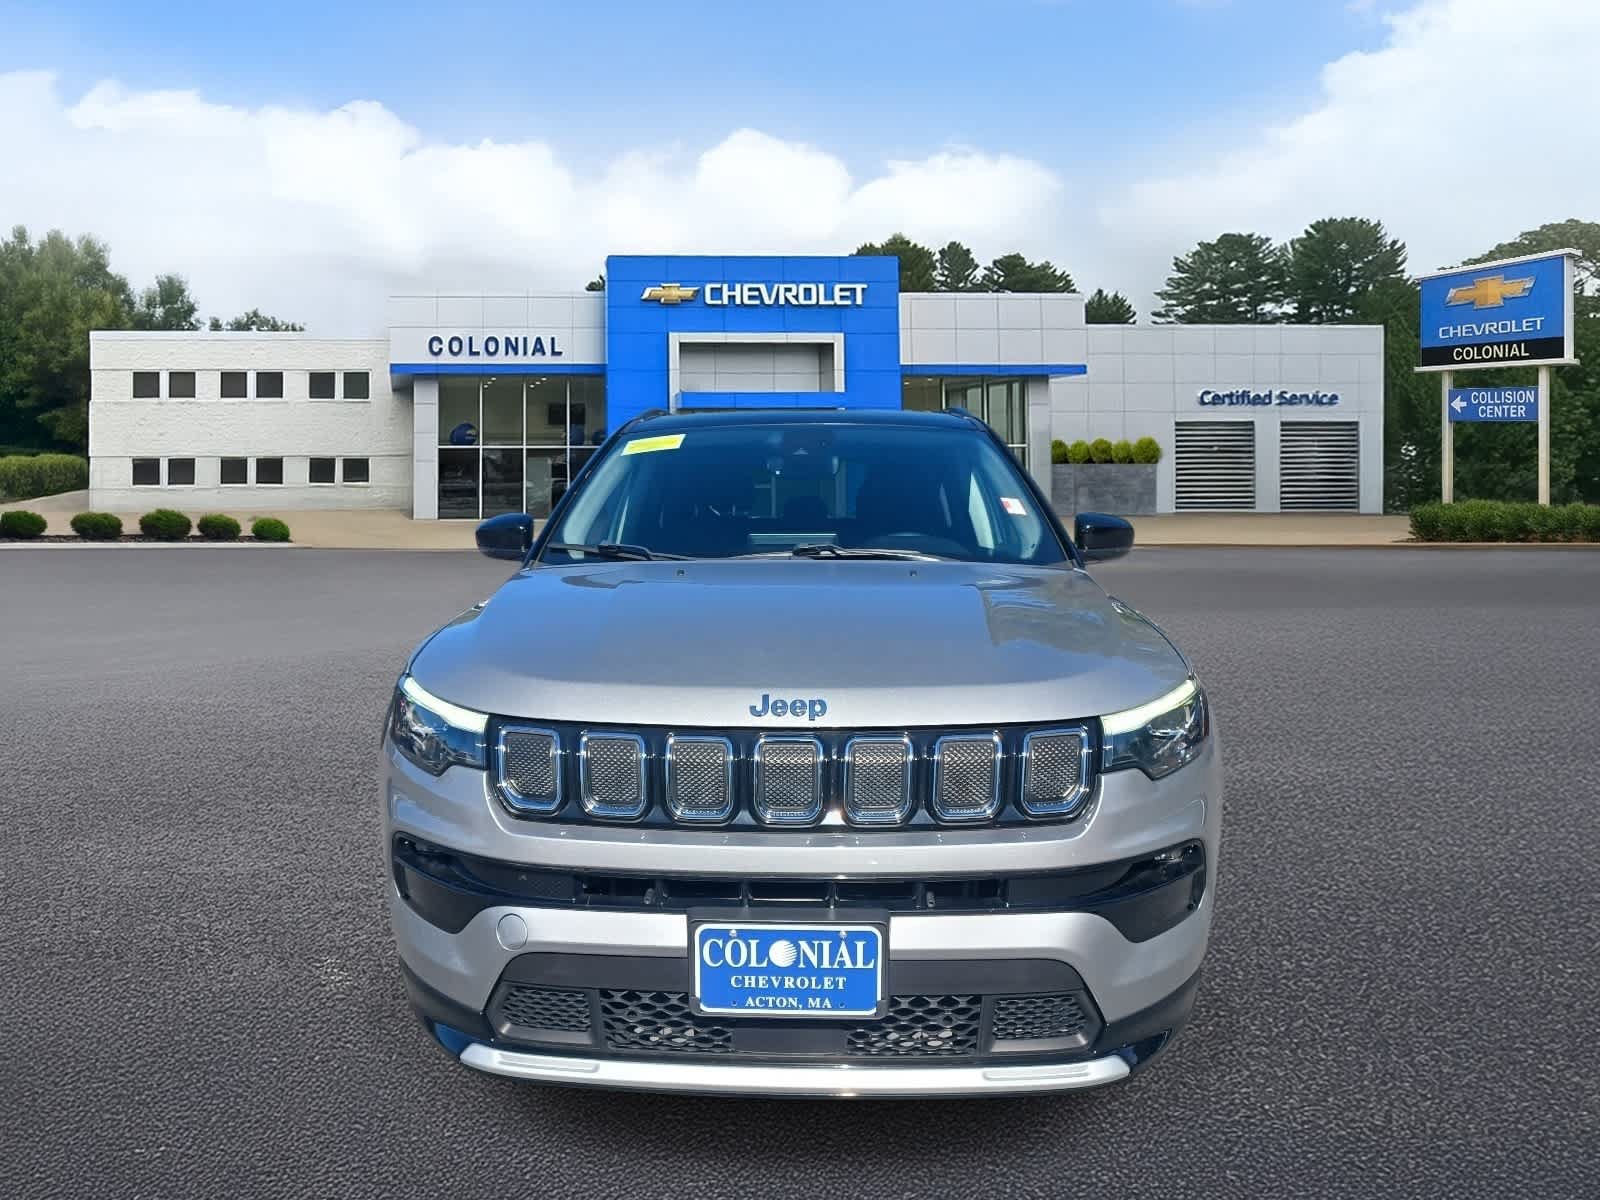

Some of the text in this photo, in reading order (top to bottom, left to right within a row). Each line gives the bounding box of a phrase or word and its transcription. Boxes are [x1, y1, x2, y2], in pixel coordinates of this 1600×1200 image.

[704, 283, 868, 306] CHEVROLET
[1439, 317, 1545, 339] CHEVROLET
[428, 335, 563, 357] COLONIAL
[1453, 342, 1530, 361] COLONIAL
[1199, 390, 1339, 406] Certified Service
[1471, 390, 1535, 404] COLLISION
[1478, 405, 1526, 418] CENTER
[749, 694, 828, 721] Jeep
[702, 938, 875, 969] COLONIAL
[730, 975, 847, 990] CHEVROLET
[745, 996, 833, 1009] ACTON, MA
